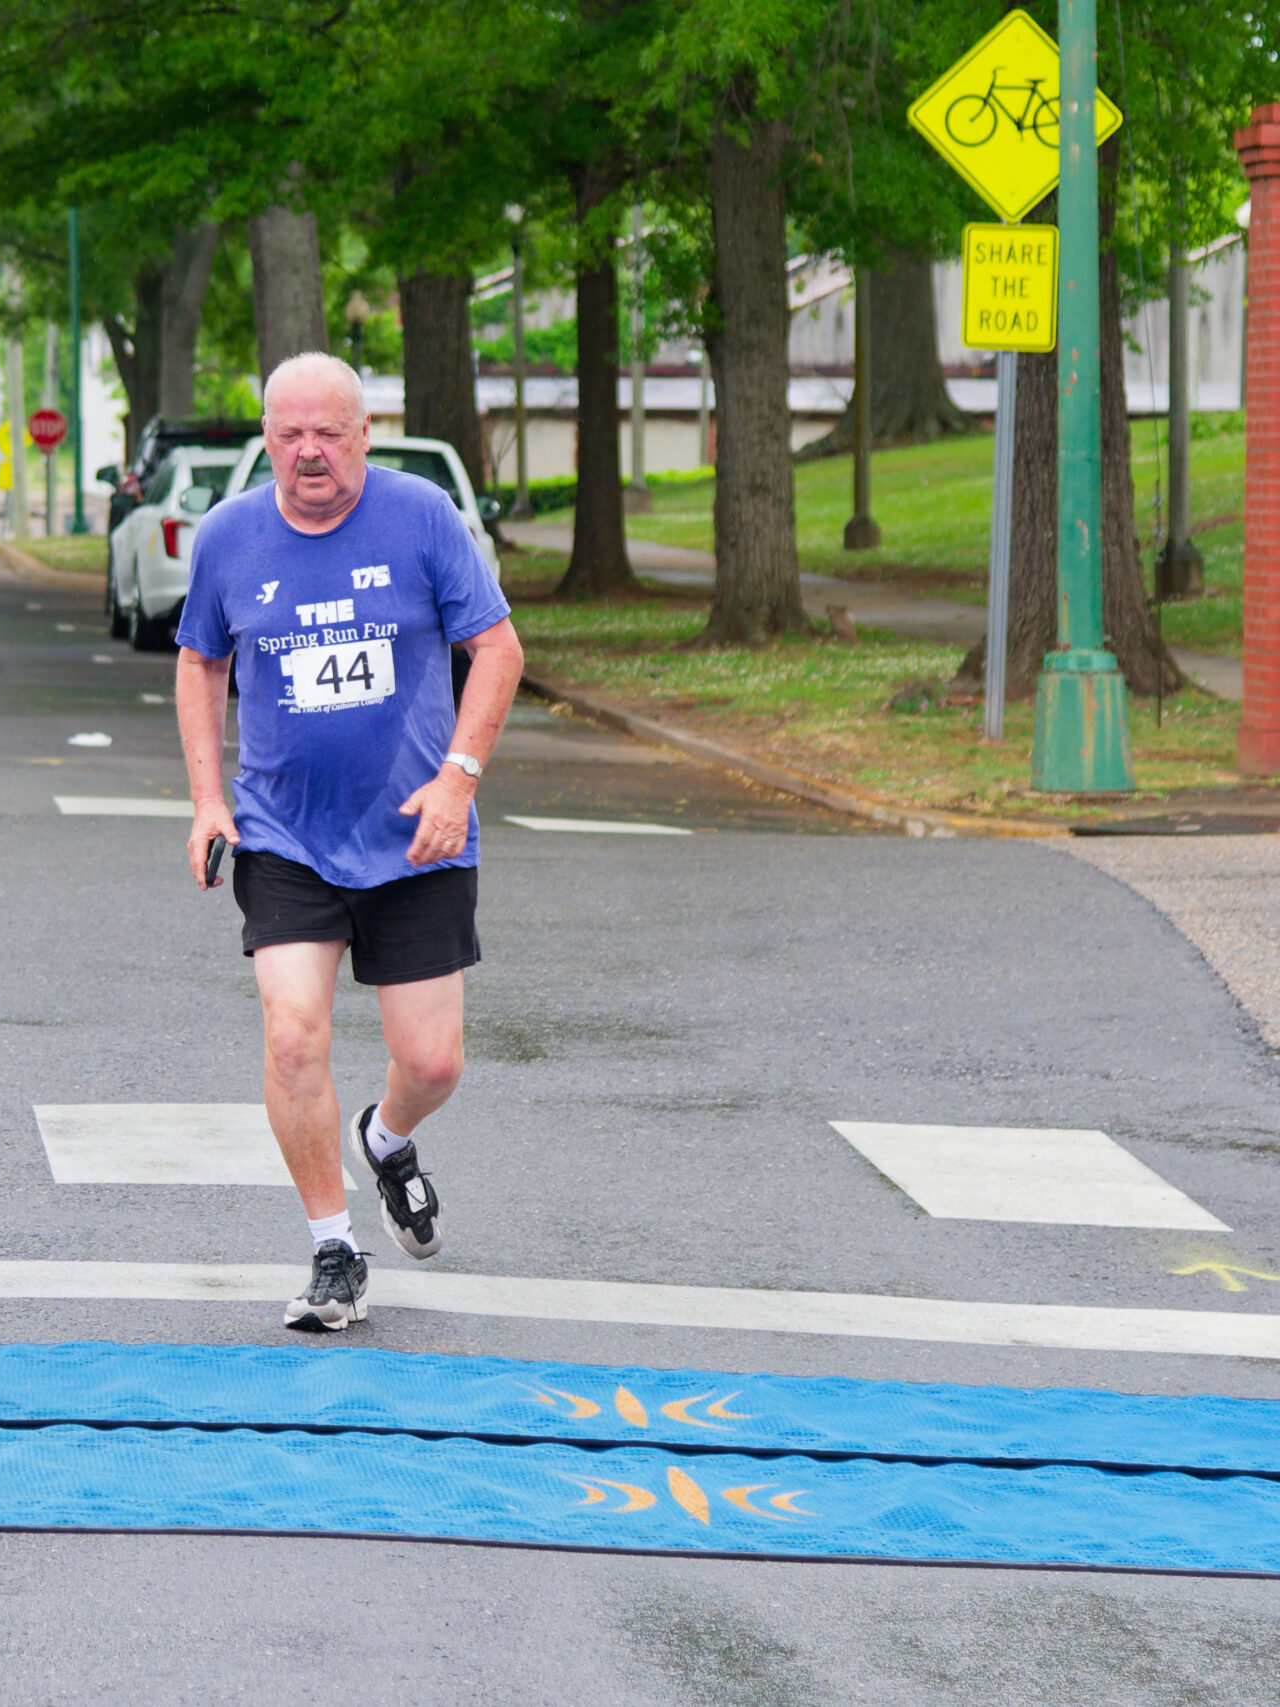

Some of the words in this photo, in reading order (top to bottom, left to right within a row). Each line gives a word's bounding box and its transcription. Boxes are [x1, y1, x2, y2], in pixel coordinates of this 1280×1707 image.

[975, 241, 1048, 265] SHARE
[991, 275, 1030, 299] THE
[979, 308, 1038, 333] ROAD
[30, 419, 65, 436] STOP
[295, 598, 355, 627] THE
[258, 632, 319, 655] Spring
[322, 627, 359, 645] Run
[362, 622, 398, 639] Fun
[316, 650, 375, 694] 44
